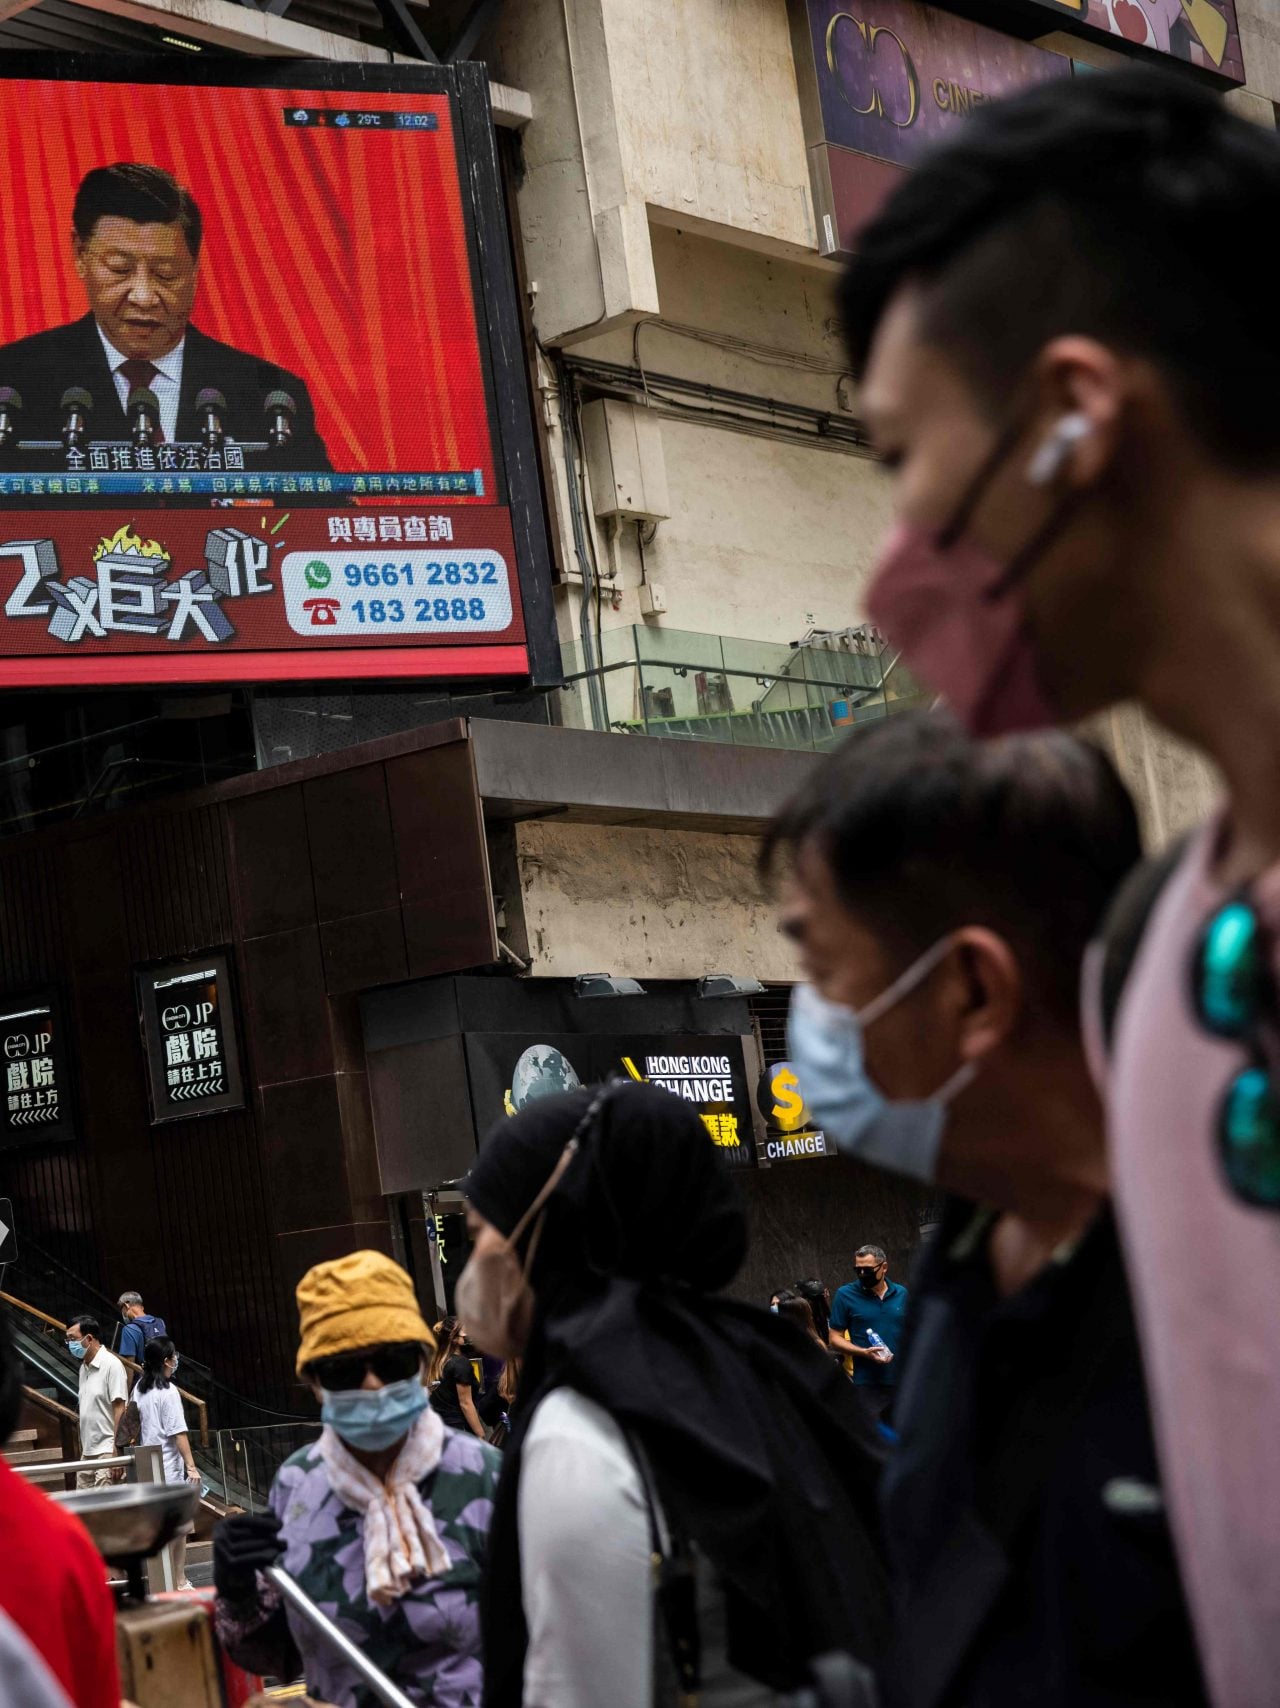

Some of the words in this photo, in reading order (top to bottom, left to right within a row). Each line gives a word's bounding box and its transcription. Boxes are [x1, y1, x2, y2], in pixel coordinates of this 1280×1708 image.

[932, 78, 992, 114] CINE
[66, 446, 245, 471] 全面推進依法治國
[327, 515, 455, 543] 與專員查詢
[344, 563, 414, 587] 9661
[426, 562, 498, 585] 2832
[351, 599, 405, 623] 183
[414, 597, 486, 622] 2888
[193, 1002, 214, 1025] JP
[31, 1032, 51, 1054] JP
[165, 1027, 219, 1066] 戲院
[7, 1057, 55, 1091] 戲院
[167, 1061, 222, 1086] 請往上方
[646, 1056, 689, 1074] HONG
[691, 1056, 731, 1074] KONG
[7, 1089, 58, 1111] 請往上方
[767, 1136, 824, 1159] CHANGE
